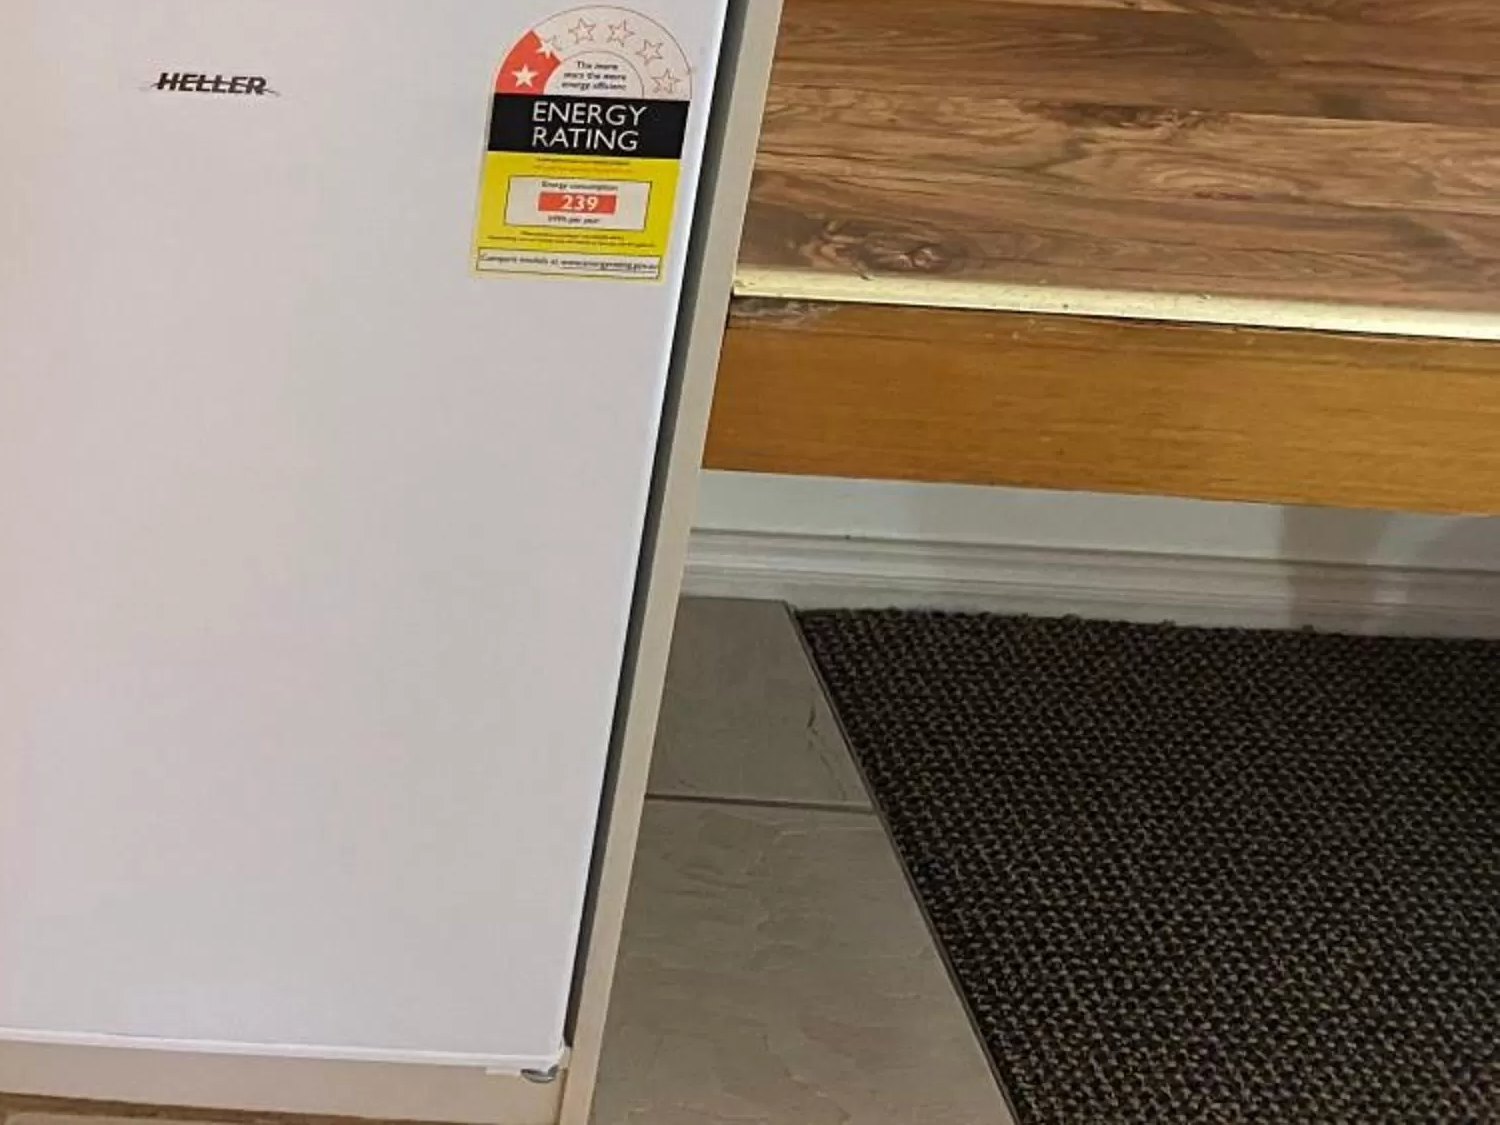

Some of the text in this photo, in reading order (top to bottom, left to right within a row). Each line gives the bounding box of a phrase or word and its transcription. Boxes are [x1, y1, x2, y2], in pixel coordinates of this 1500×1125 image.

[156, 72, 267, 95] HELLER
[531, 101, 648, 126] ENERGY
[531, 127, 640, 152] RATING
[541, 181, 568, 190] Energy
[562, 194, 599, 212] 239
